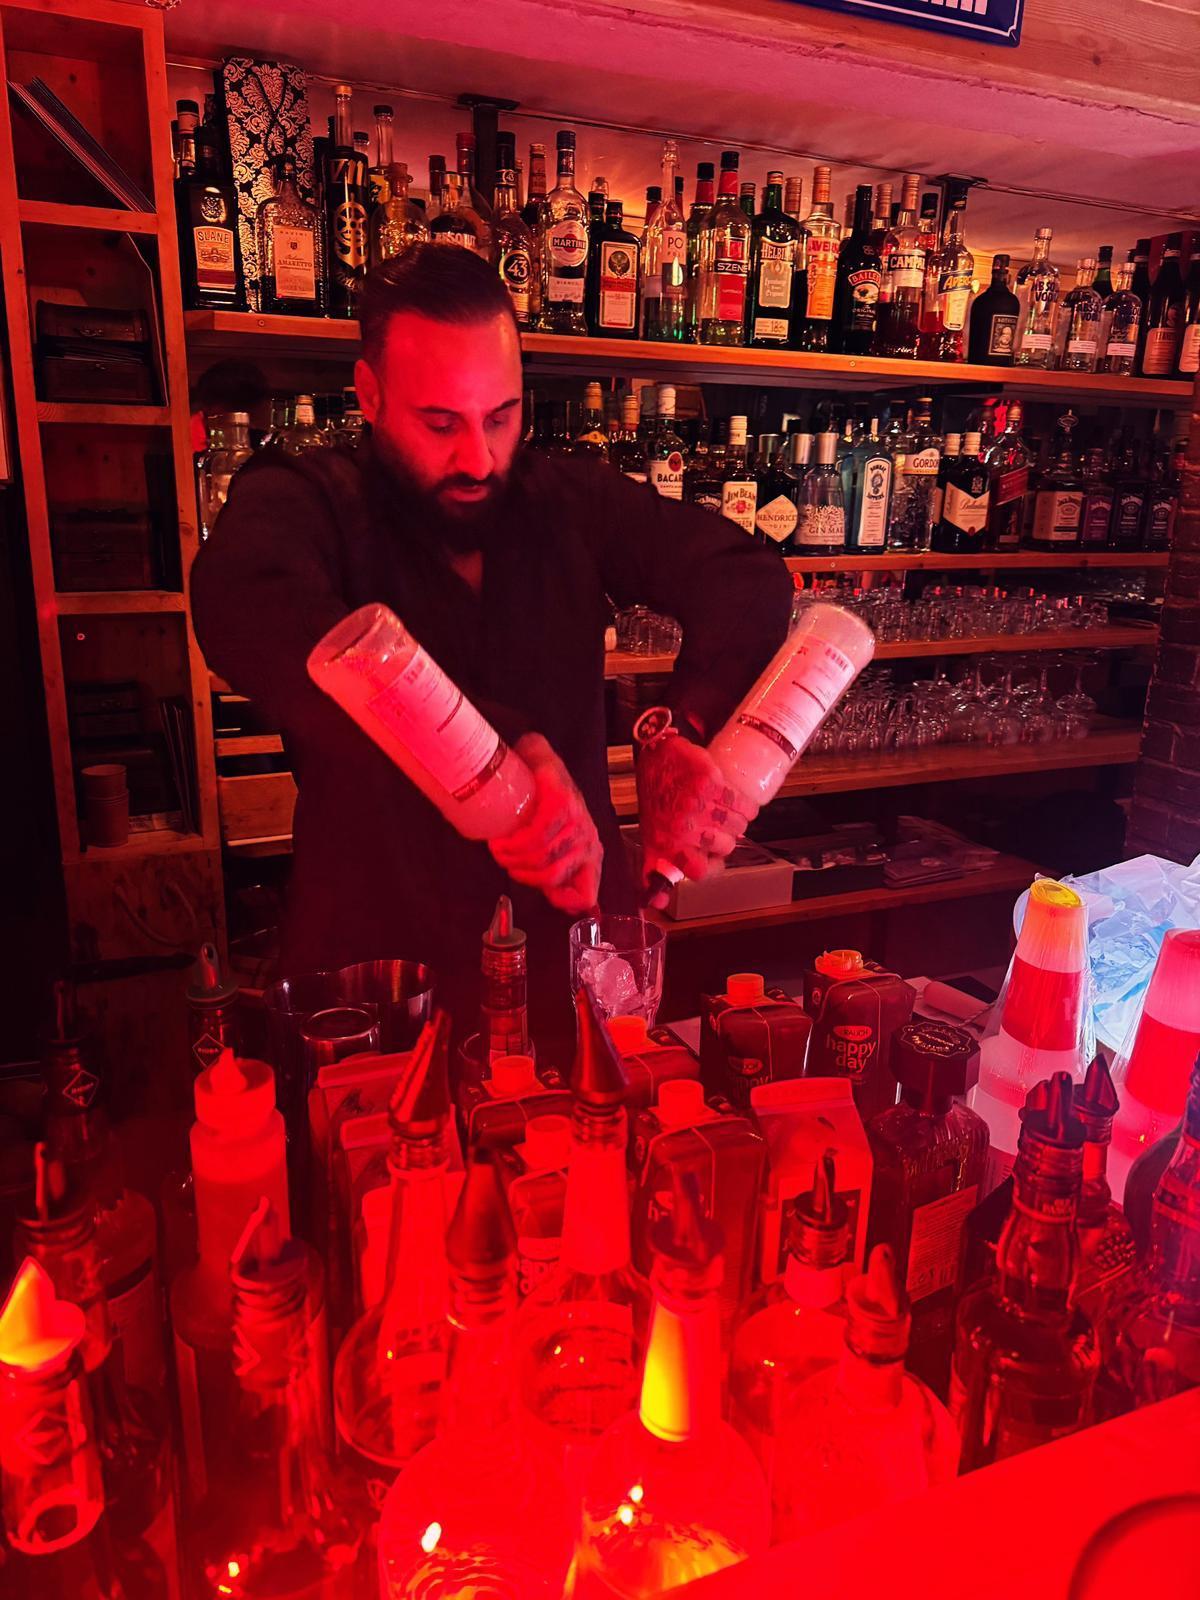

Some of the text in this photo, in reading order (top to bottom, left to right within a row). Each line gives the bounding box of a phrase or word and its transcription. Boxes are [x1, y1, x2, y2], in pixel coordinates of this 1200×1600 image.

[197, 231, 229, 244] SLANE
[553, 239, 587, 250] MARTINI
[507, 260, 528, 278] 43
[725, 491, 739, 504] JIM
[808, 526, 826, 534] GIN
[826, 1033, 877, 1058] happy
[835, 1055, 868, 1074] day
